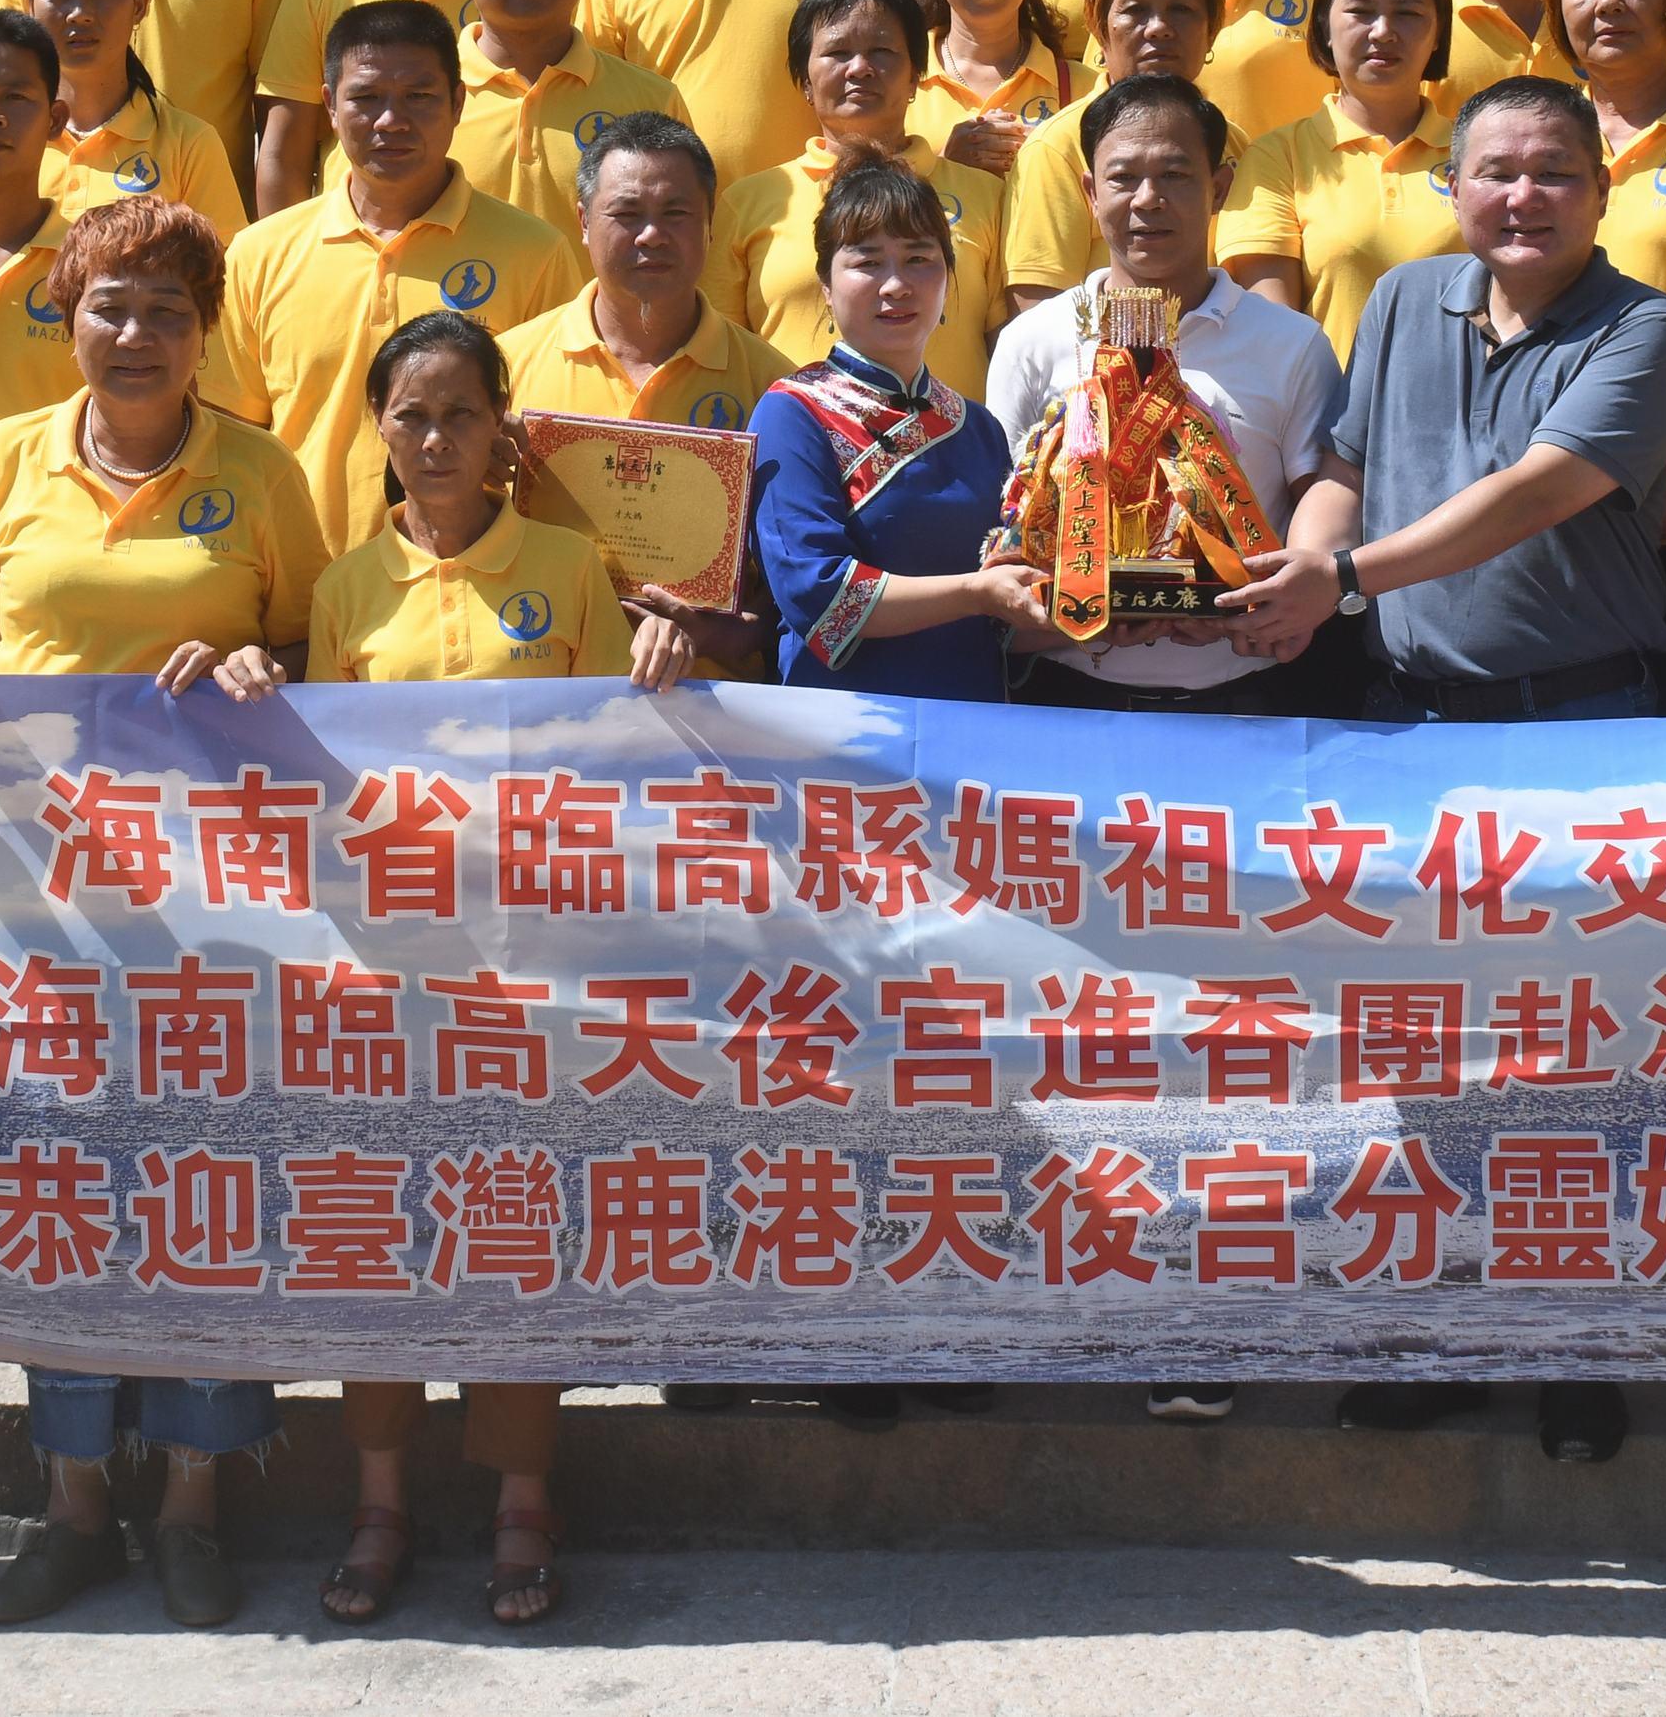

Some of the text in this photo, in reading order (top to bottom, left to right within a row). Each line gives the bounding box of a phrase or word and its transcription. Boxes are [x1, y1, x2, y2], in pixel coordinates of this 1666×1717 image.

[26, 324, 71, 344] MAZU
[1068, 459, 1103, 577] 天上聖母
[182, 537, 231, 553] MAZU
[509, 642, 552, 661] MAZU
